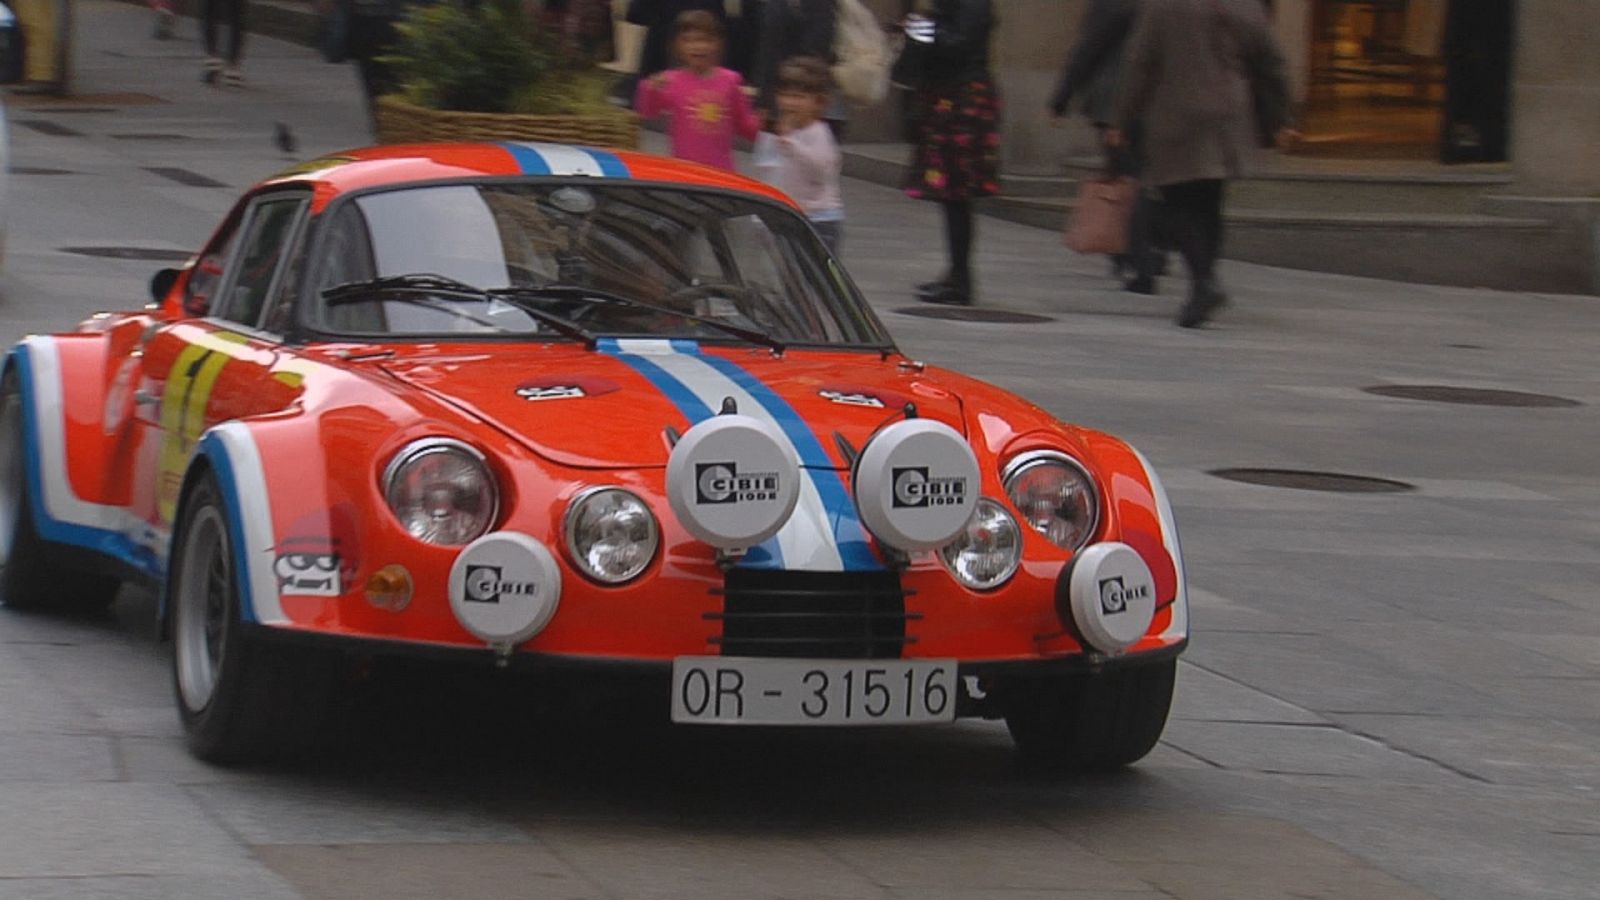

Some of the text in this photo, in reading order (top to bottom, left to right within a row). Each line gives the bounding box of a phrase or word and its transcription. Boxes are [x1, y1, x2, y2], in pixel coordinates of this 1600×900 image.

[712, 477, 777, 491] CIBIE
[906, 481, 964, 495] CIBIE
[479, 581, 536, 595] CIBIE
